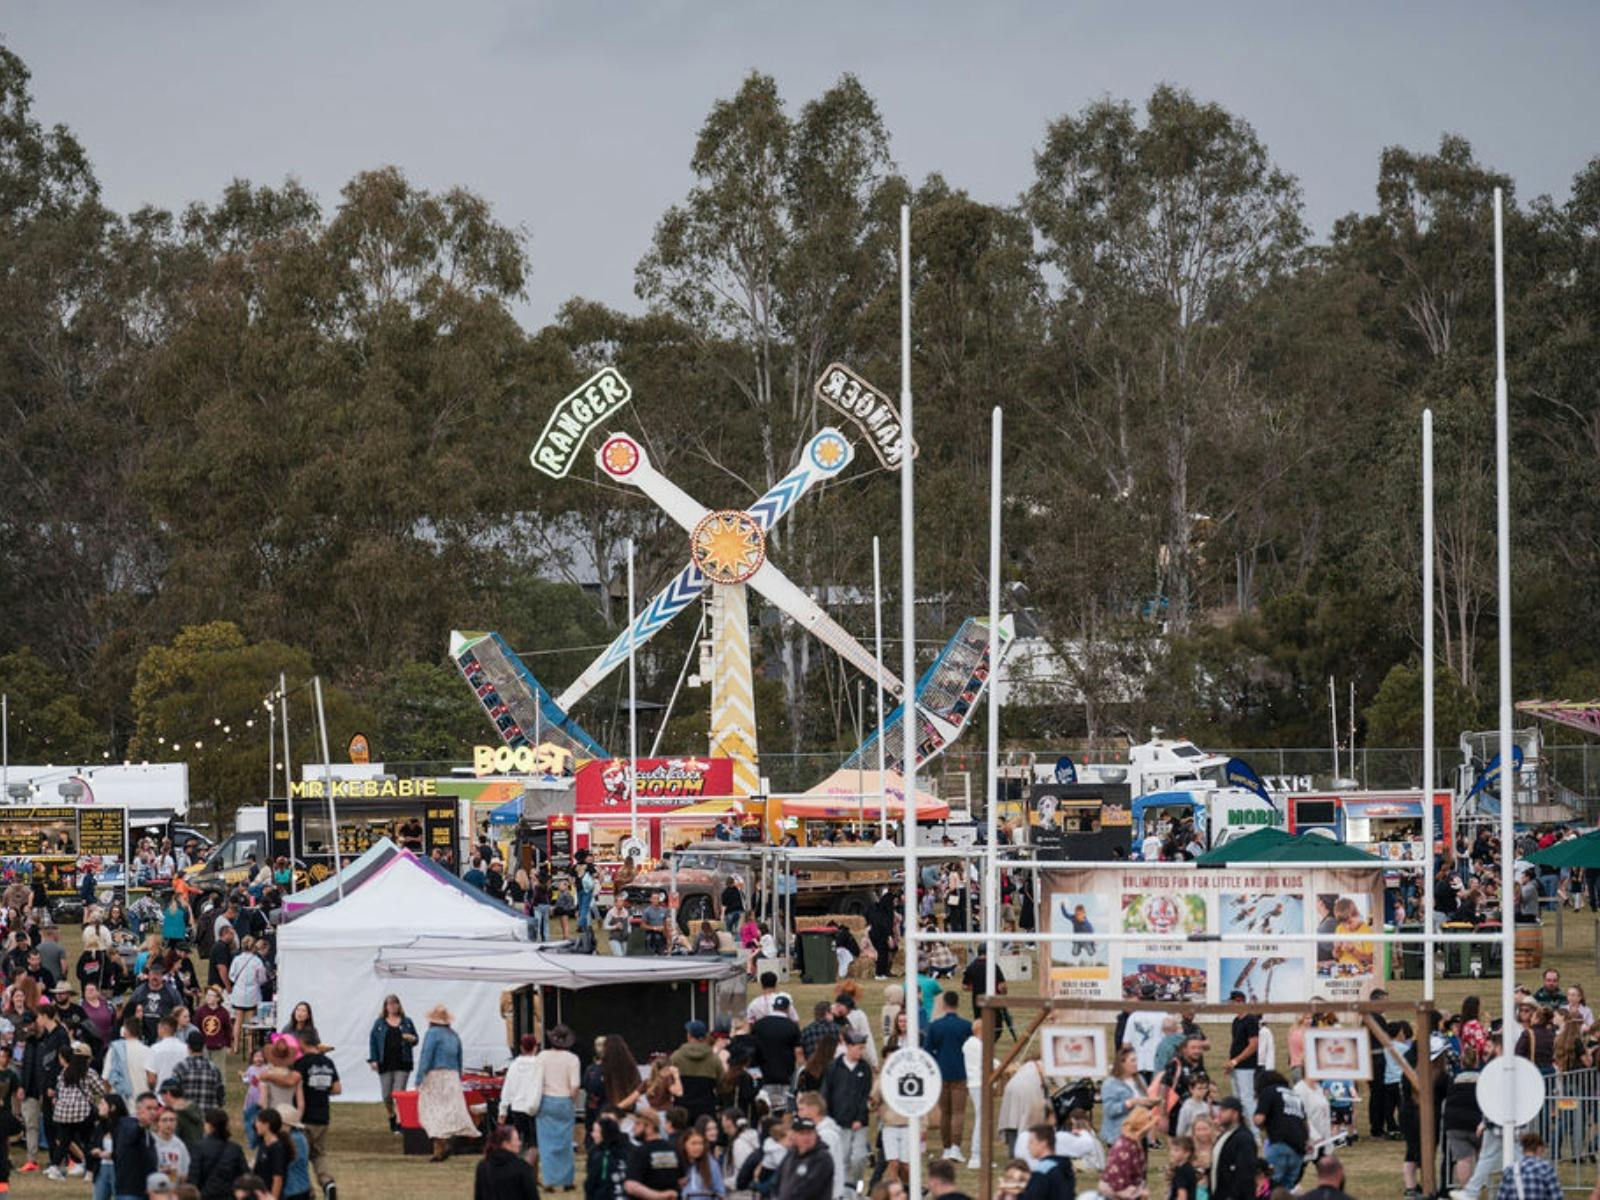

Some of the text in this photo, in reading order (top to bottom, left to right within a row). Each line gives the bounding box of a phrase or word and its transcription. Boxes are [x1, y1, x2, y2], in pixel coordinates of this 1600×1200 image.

[539, 375, 624, 472] RANGER
[473, 742, 573, 776] BOOST
[290, 778, 437, 798] MR KEBABIE
[635, 779, 705, 797] BOOM
[1123, 876, 1303, 888] UNLIMITED FUN FOR LITTLE AND BIG KIDS
